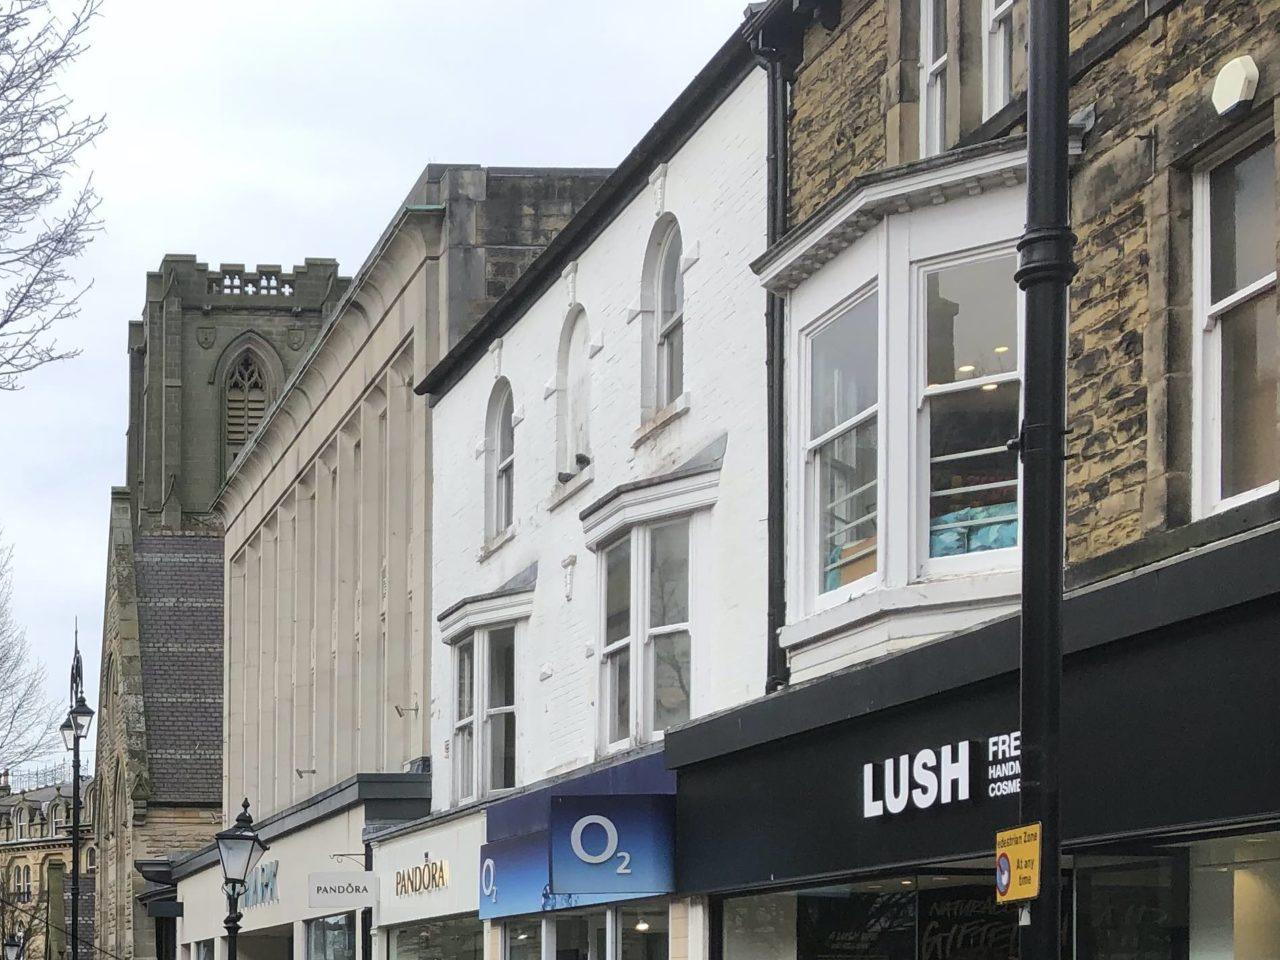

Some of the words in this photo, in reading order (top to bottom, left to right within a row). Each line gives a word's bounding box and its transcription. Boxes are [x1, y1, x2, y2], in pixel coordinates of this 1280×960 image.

[863, 739, 969, 818] LUSH
[1023, 831, 1038, 845] Zone
[1016, 858, 1026, 870] At
[1026, 858, 1035, 871] any
[395, 860, 446, 897] PANDORA
[1018, 876, 1033, 887] time
[316, 884, 369, 895] PANDORA
